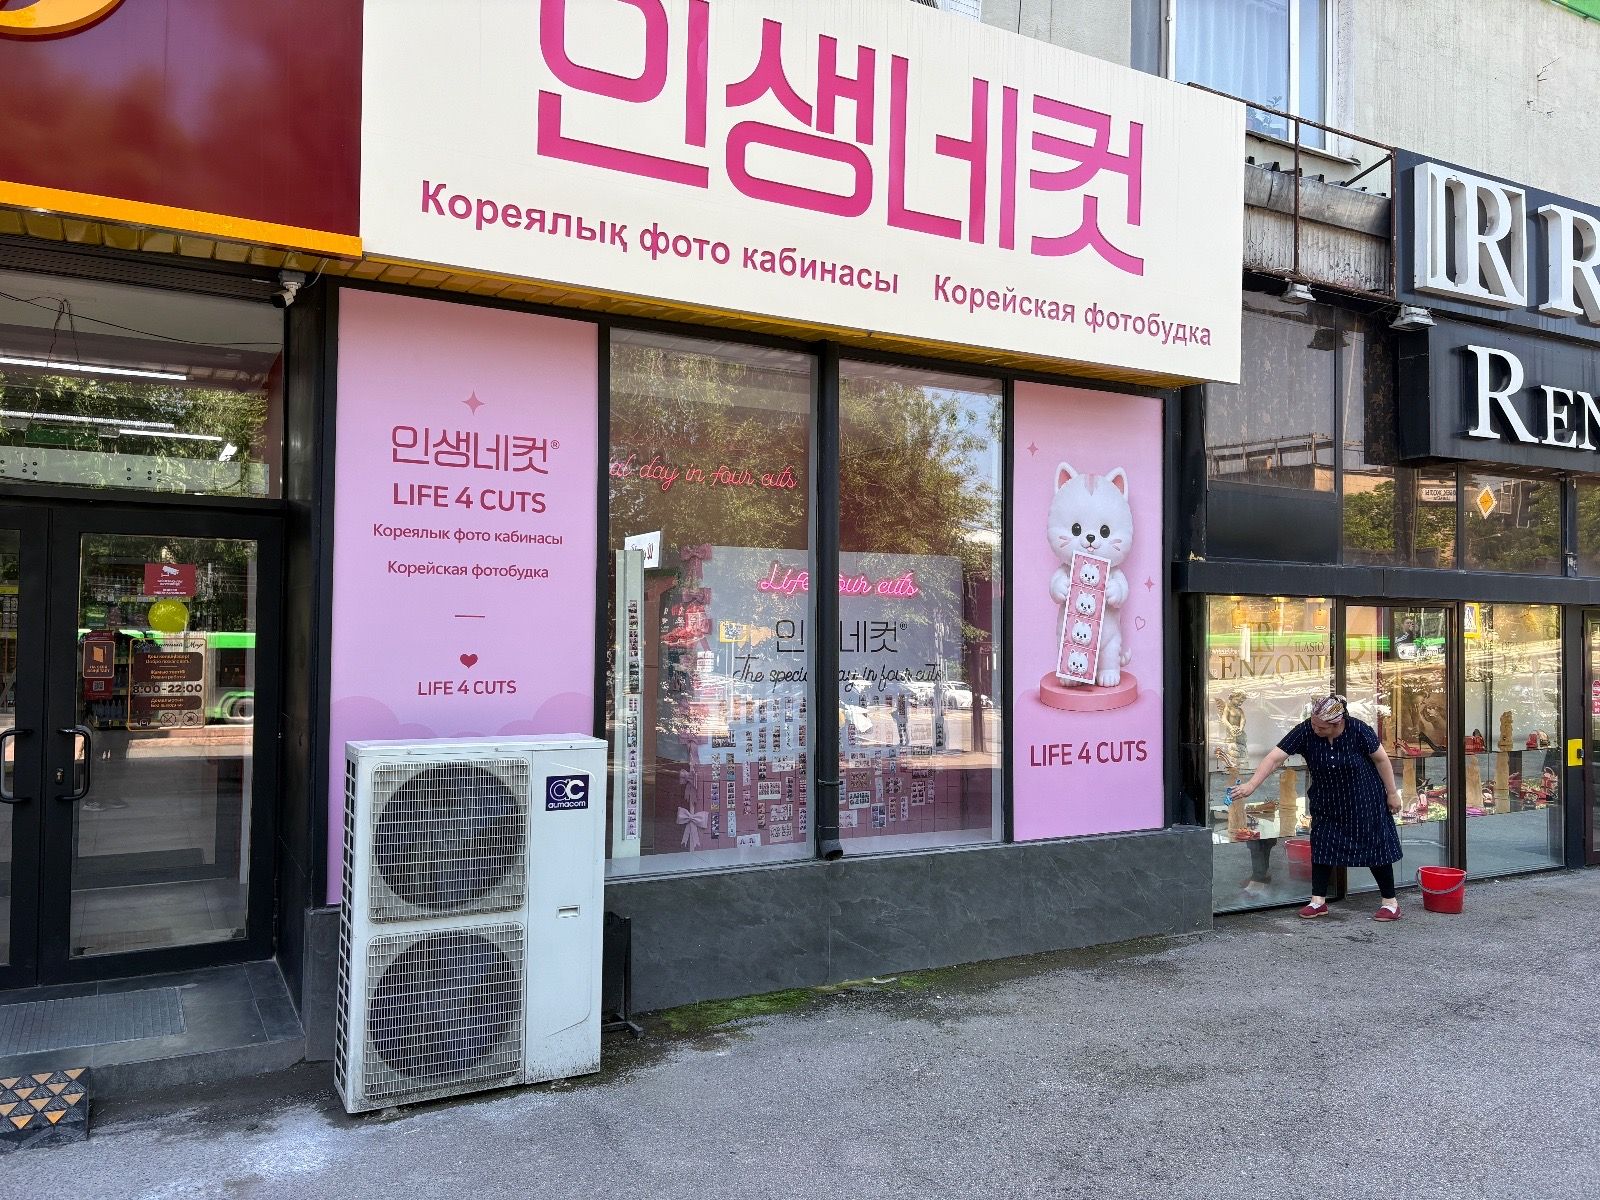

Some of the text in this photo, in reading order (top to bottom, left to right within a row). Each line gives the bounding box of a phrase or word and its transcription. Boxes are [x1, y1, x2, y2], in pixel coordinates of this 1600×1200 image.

[421, 180, 1211, 346] Кореялық фото кабинасы Корейская фотобудка
[640, 455, 680, 491] day
[685, 463, 705, 482] in
[710, 465, 755, 488] four
[761, 465, 798, 489] cuts
[393, 482, 547, 514] LIFE 4 CUTS
[373, 523, 563, 546] Кореялык фото кабинасы
[387, 560, 549, 581] Корейская фотобудка
[838, 573, 872, 594] our
[877, 570, 919, 597] cuts
[733, 654, 764, 683] The
[838, 668, 861, 693] ay
[862, 664, 878, 682] in
[418, 679, 517, 696] LIFE 4 CUTS
[1030, 740, 1148, 767] LIFE 4 CUTS
